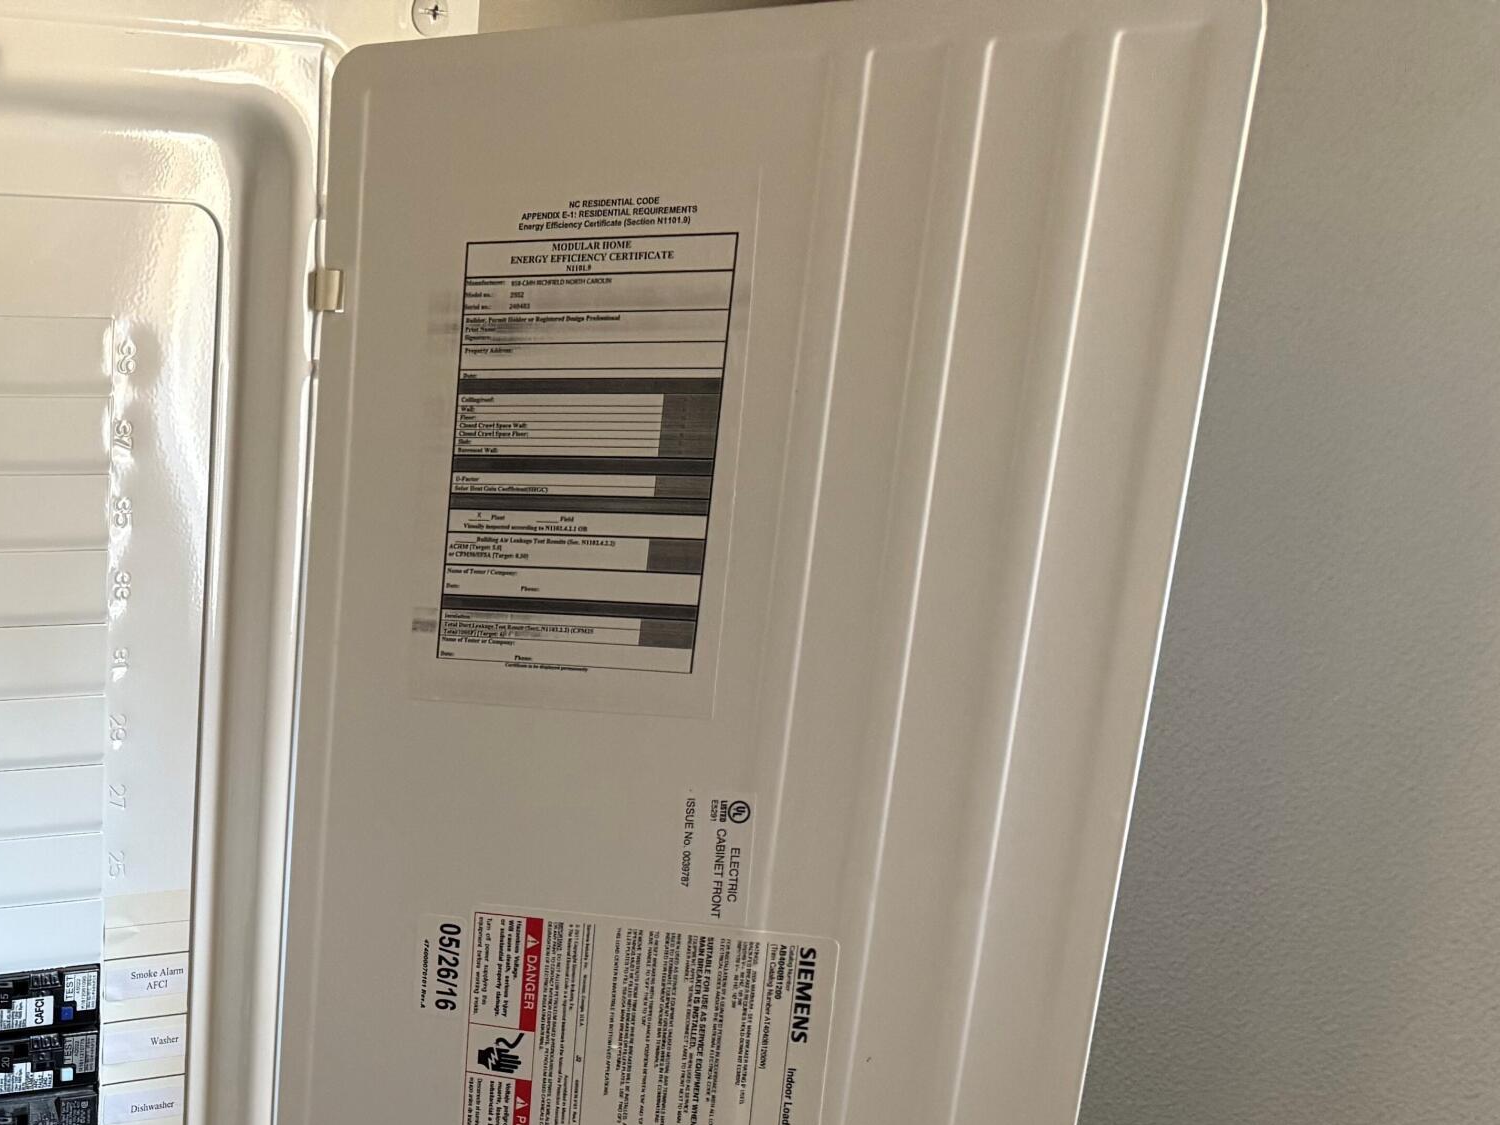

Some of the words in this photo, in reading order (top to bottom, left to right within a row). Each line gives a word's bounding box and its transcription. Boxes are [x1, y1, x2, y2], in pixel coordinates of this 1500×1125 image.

[521, 211, 560, 221] APPENDIX
[562, 210, 577, 219] E-1:
[578, 207, 630, 218] RESIDENTIAL
[632, 205, 698, 216] REQUIREMENTS
[569, 200, 580, 208] NC
[582, 198, 635, 208] RESIDENTIAL
[636, 196, 660, 205] CODE
[518, 222, 544, 231] Energy
[545, 220, 582, 230] Efficiency
[583, 218, 622, 228] Certificate
[623, 217, 656, 227] (Section
[510, 255, 548, 264] ENERGY
[550, 253, 608, 263] EFFICIENCY
[609, 250, 675, 261] CERTIFICATE
[551, 242, 600, 252] MODULAR
[602, 240, 632, 250] HOME
[108, 783, 126, 810] 27
[685, 797, 695, 829] ISSUE
[720, 800, 728, 823] LISTED
[683, 831, 693, 848] No.
[107, 850, 126, 880] 25
[713, 828, 727, 878] CABINET
[727, 847, 740, 903] ELECTRIC
[710, 880, 723, 919] FRONT
[130, 968, 158, 980] Smoke
[159, 967, 184, 977] Alarm
[434, 922, 462, 1012] 05/26/16
[65, 975, 74, 1000] TEST
[146, 980, 168, 990] AFCI
[523, 954, 539, 1010] DANGER
[0, 993, 9, 1004] 15
[791, 947, 817, 1044] SIEMENS
[34, 998, 45, 1025] CAFCI
[63, 1038, 72, 1063] TEST
[150, 1035, 179, 1046] Washer
[1, 1057, 10, 1068] 20
[784, 1067, 797, 1100] Indoor
[130, 1100, 175, 1113] Dishwasher
[781, 1101, 793, 1125] Load
